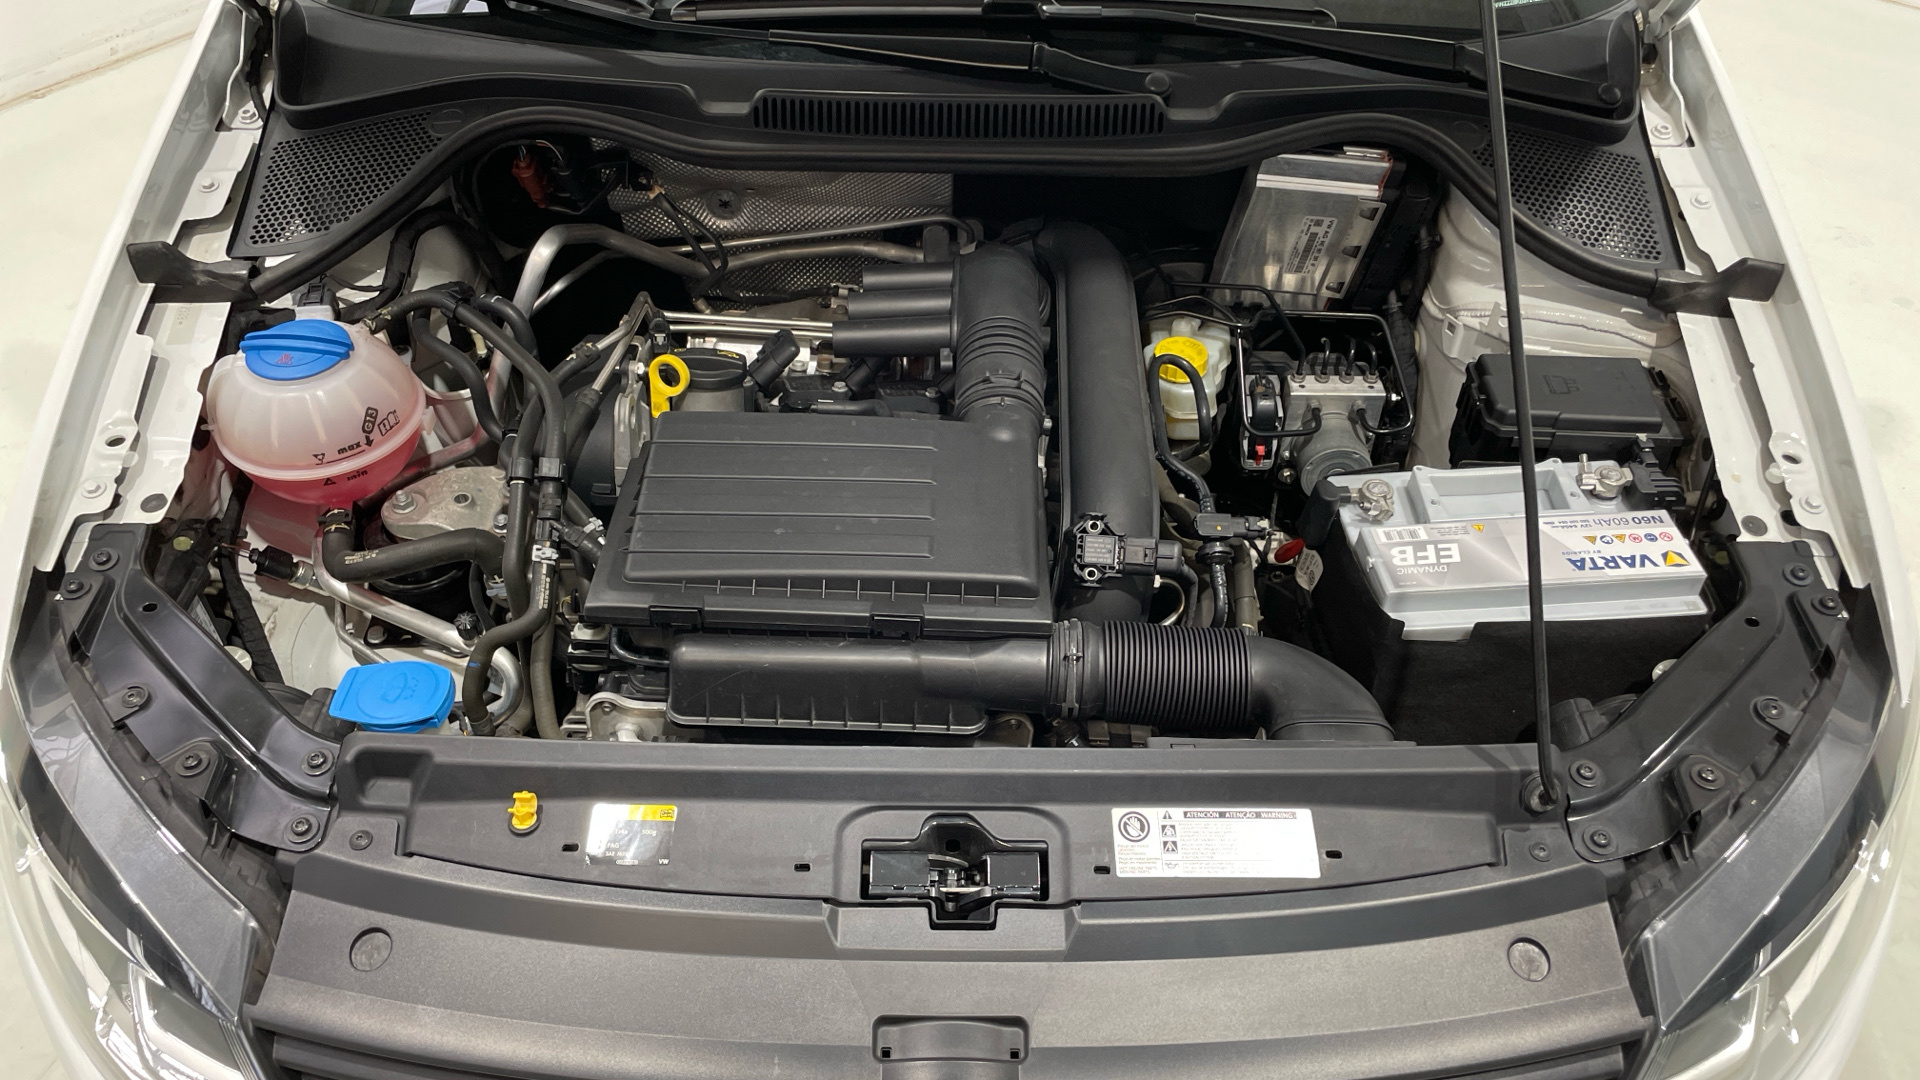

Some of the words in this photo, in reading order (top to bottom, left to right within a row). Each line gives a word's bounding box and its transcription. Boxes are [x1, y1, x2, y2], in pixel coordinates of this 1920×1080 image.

[364, 409, 377, 431] G13
[337, 441, 362, 455] max
[346, 469, 369, 481] min
[1592, 517, 1630, 527] 60Ah
[1632, 515, 1664, 525] N60
[1390, 543, 1461, 566] EFB
[1566, 554, 1660, 571] VARTA
[1397, 565, 1448, 575] DYNAMIC
[1225, 811, 1256, 819] ATENÇÃO
[642, 829, 657, 837] 500g
